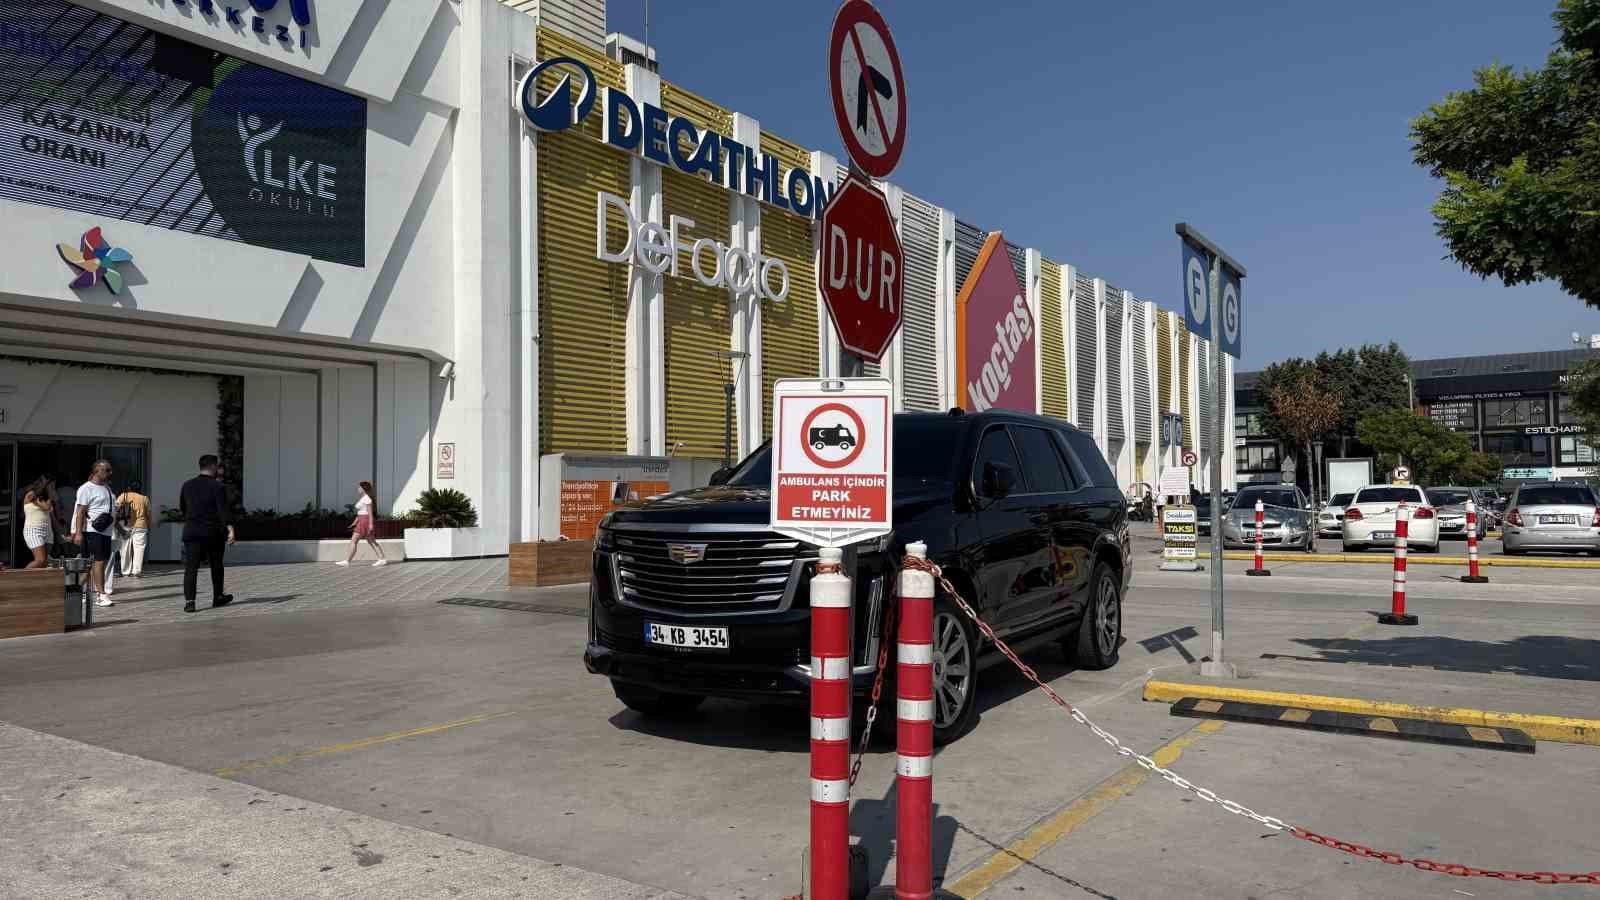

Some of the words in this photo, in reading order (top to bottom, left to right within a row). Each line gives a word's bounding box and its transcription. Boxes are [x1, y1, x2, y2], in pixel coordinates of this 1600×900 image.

[22, 105, 152, 151] KAZANMA
[20, 134, 107, 169] ORANI
[602, 86, 836, 220] DECATHLON
[248, 187, 337, 219] OKULU
[597, 191, 790, 302] DeFacto
[829, 223, 896, 314] DUR
[1192, 268, 1201, 311] F
[1225, 295, 1236, 333] G
[968, 294, 1034, 413] koçtaş
[780, 477, 839, 487] AMBULANS
[843, 477, 885, 489] İÇİNDİR
[812, 490, 851, 502] PARK
[791, 505, 872, 519] ETMEYİNİZ
[1167, 523, 1194, 533] TAKSİ
[651, 625, 665, 642] 34
[670, 627, 686, 645] KB
[692, 628, 727, 646] 3454
